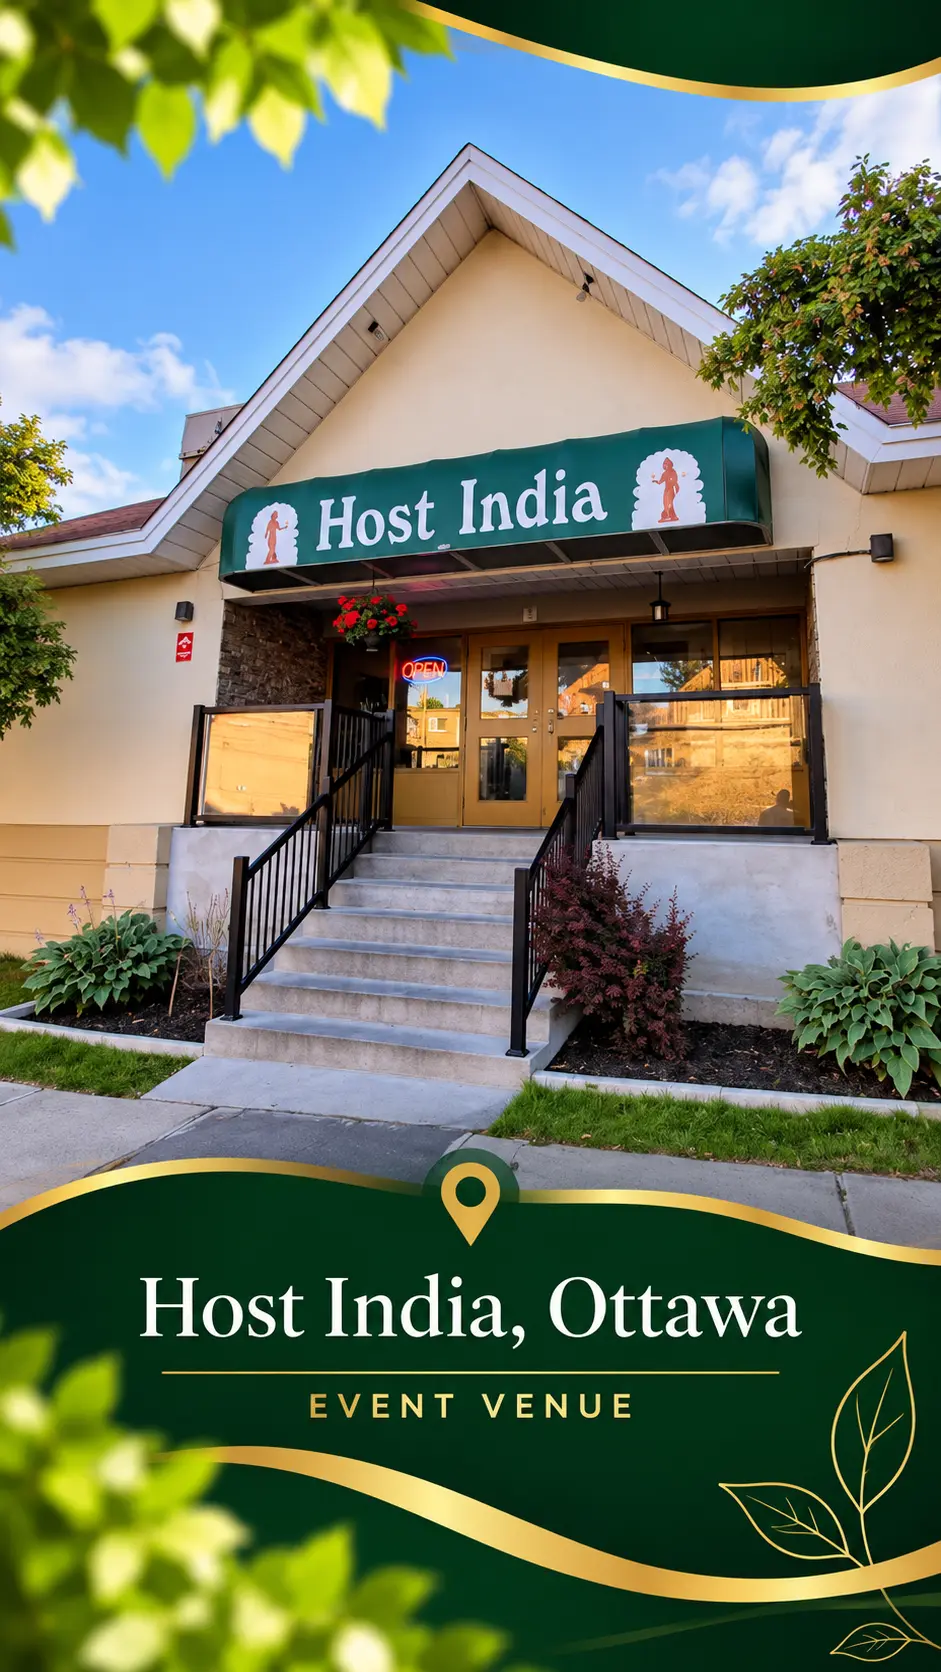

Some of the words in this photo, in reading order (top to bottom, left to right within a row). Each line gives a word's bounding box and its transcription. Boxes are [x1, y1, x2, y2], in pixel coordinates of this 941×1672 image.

[316, 490, 436, 551] Host
[459, 468, 608, 535] India
[402, 661, 445, 679] OPEN
